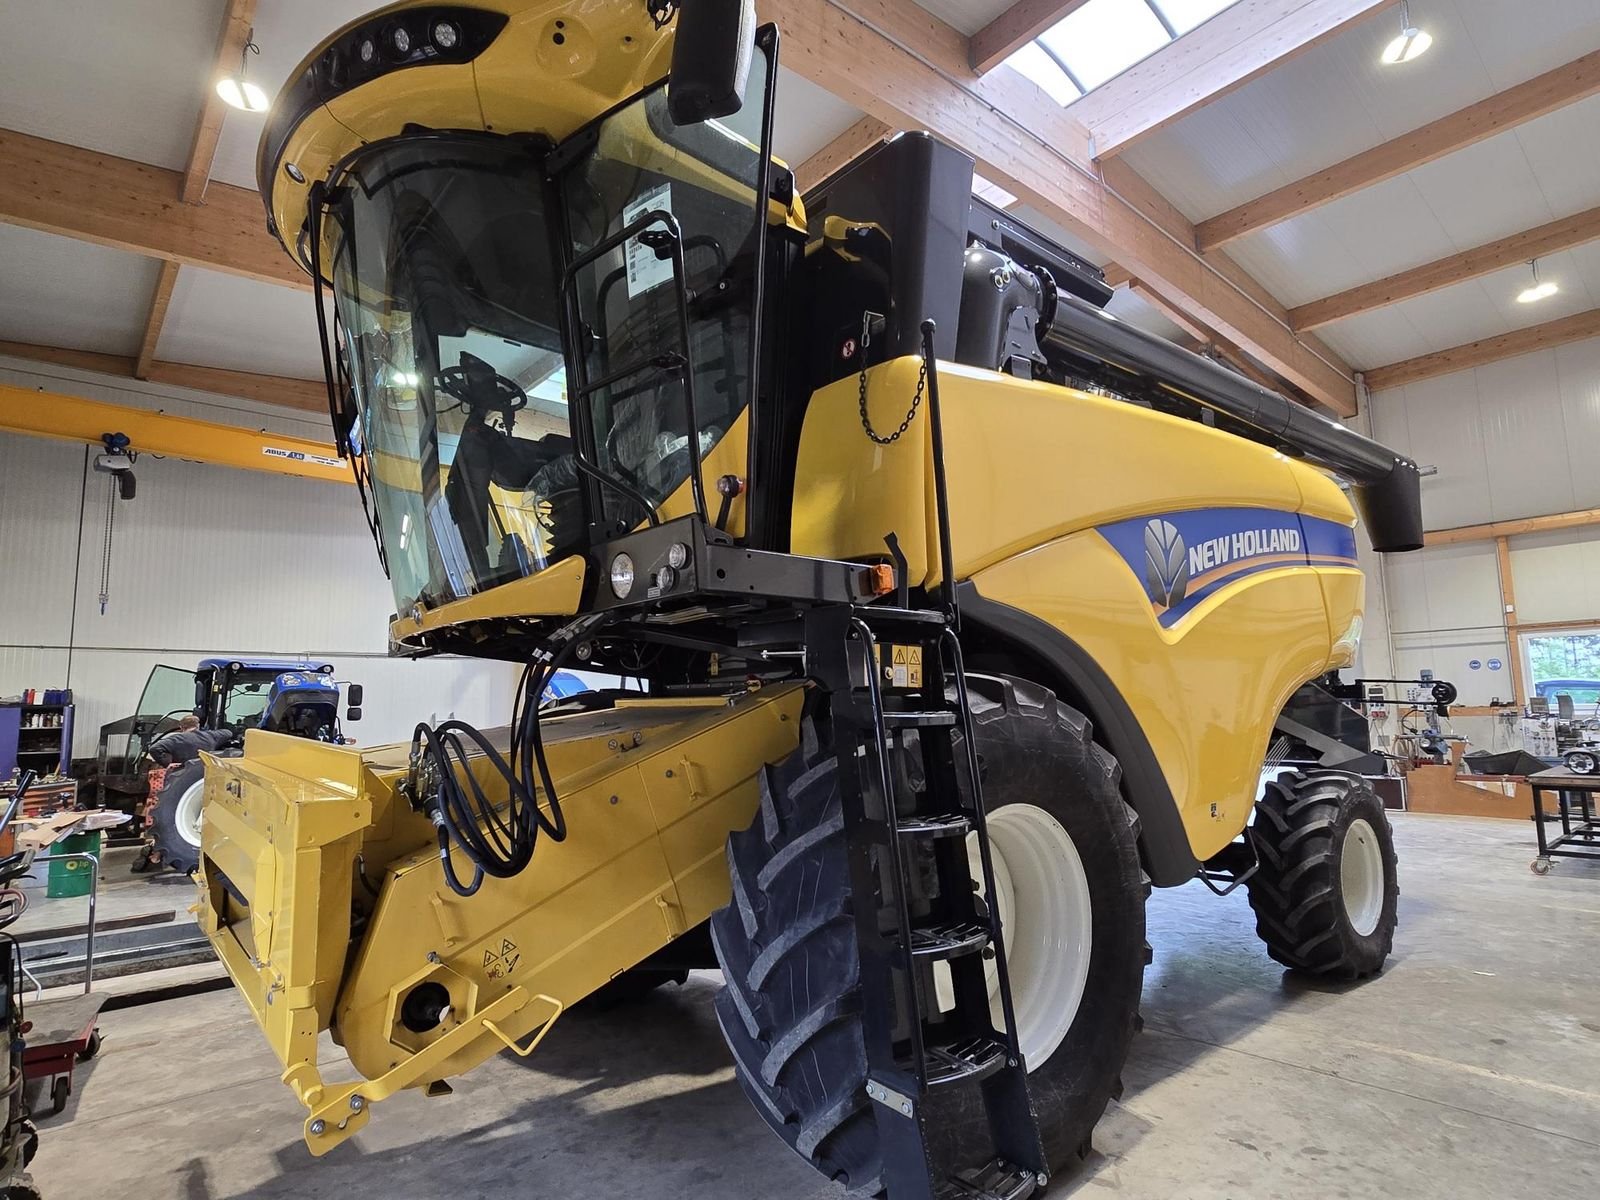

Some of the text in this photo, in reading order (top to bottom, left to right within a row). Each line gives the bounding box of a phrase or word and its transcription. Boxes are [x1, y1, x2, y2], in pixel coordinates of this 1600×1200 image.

[265, 448, 286, 456] ABUS
[1189, 529, 1300, 575] NEW HOLLAND
